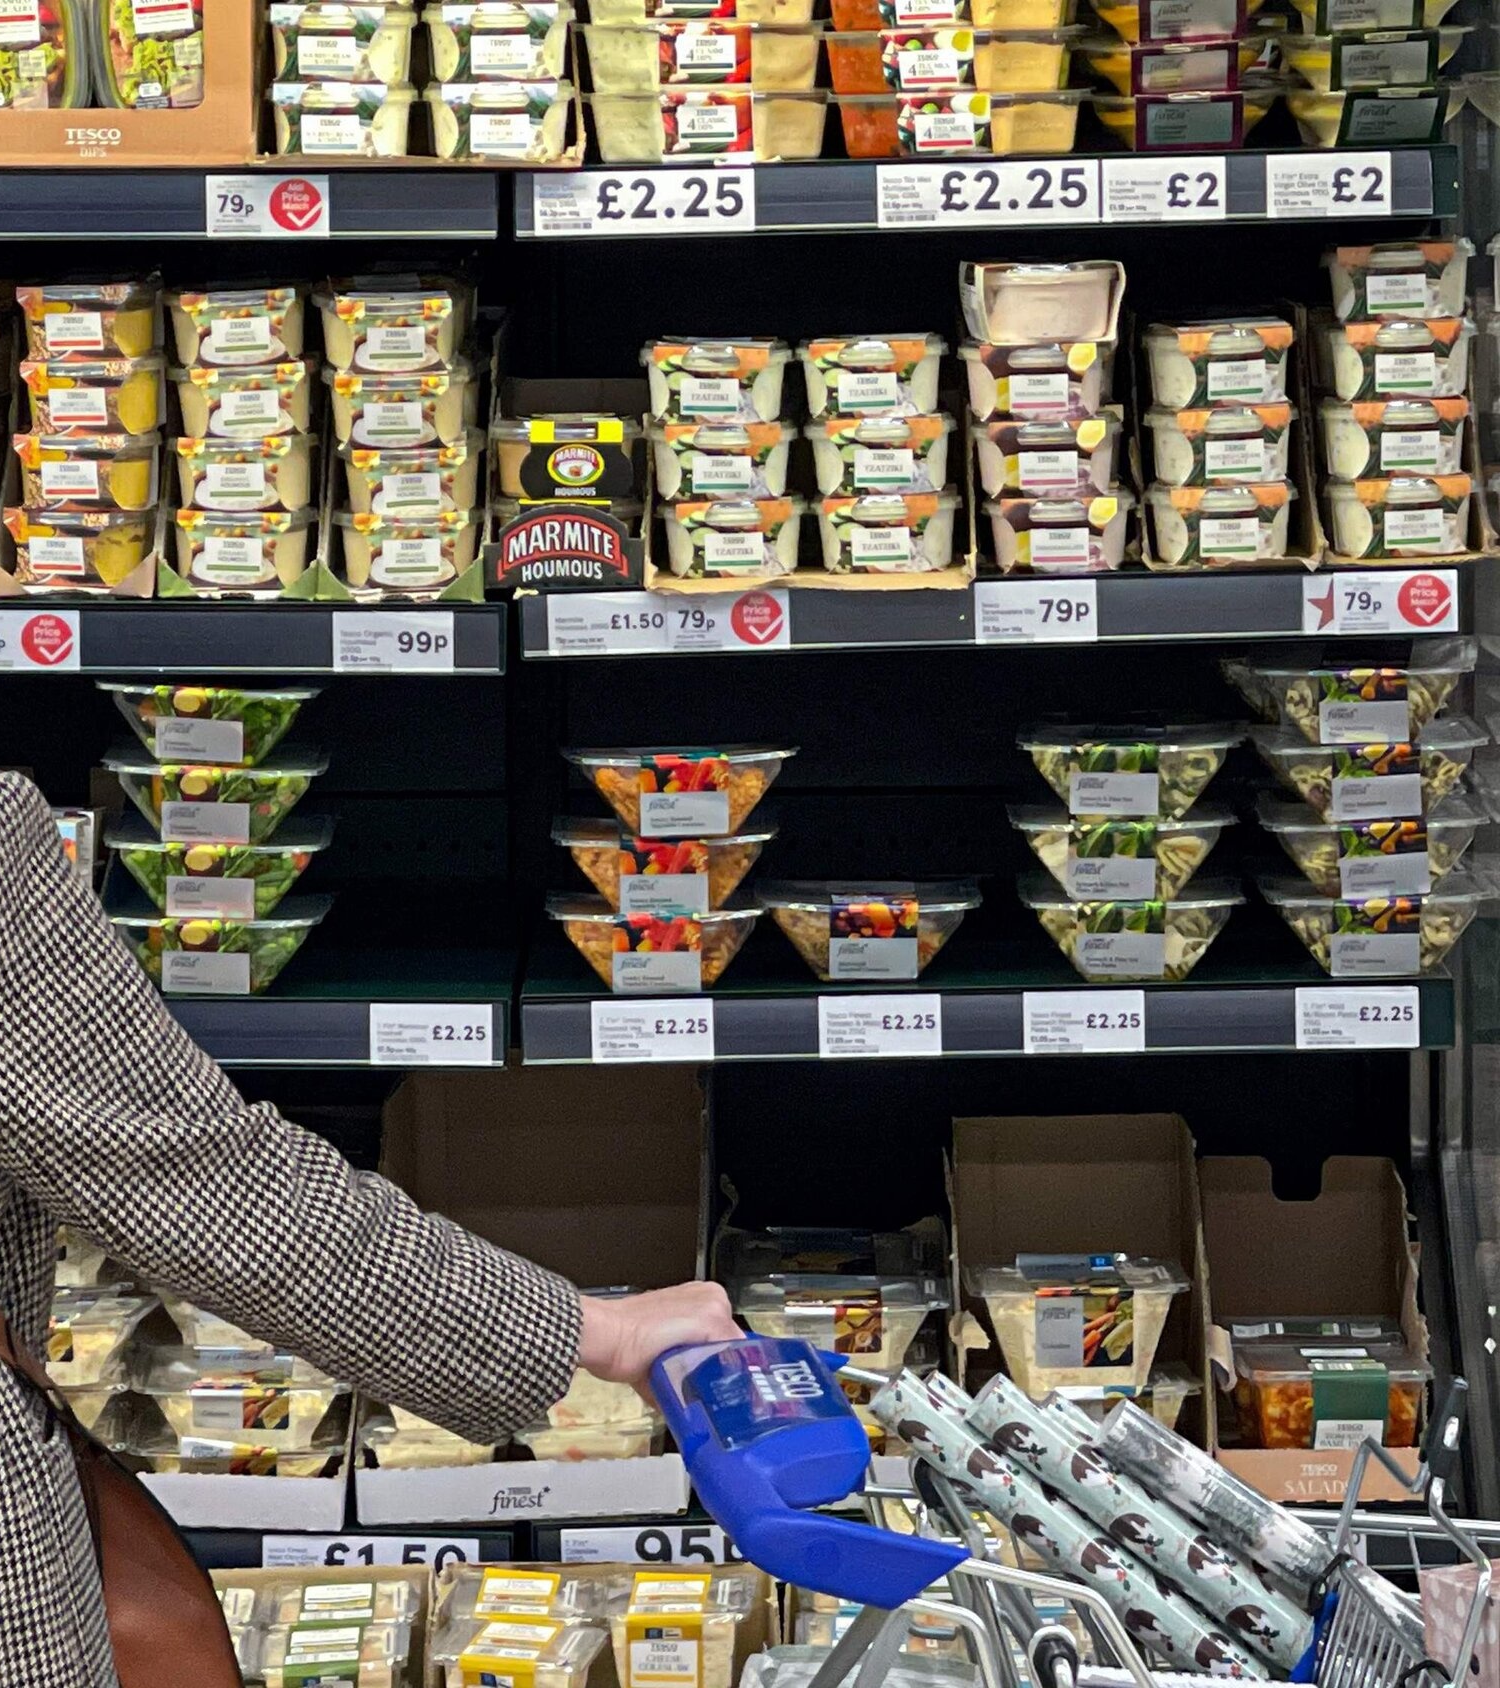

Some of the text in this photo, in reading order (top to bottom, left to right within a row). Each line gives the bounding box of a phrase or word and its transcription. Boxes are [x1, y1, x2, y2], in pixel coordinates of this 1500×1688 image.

[686, 48, 694, 61] 4
[908, 63, 917, 76] 4
[687, 118, 696, 130] 4
[65, 128, 121, 142] TESCO
[923, 127, 932, 139] 4
[940, 168, 1087, 211] £2.25
[1167, 172, 1219, 207] £2
[1332, 166, 1384, 202] £2
[216, 194, 254, 216] 79p
[281, 192, 310, 203] Price
[597, 176, 743, 219] £2.25
[554, 448, 596, 463] MARMITE
[507, 521, 615, 562] MARMITE
[521, 560, 604, 583] HOUMOUS
[1410, 588, 1438, 598] Price
[742, 605, 771, 616] Price
[1039, 599, 1089, 622] 79p
[1344, 592, 1382, 613] 79p
[611, 612, 664, 629] £1.50
[678, 609, 715, 631] 79p
[33, 627, 61, 637] Price
[397, 631, 448, 653] 99p
[1086, 1013, 1141, 1029] £2.25
[1359, 1005, 1414, 1021] £2.25
[655, 1018, 708, 1034] £2.25
[882, 1014, 936, 1030] £2.25
[433, 1025, 486, 1041] £2.25
[769, 1360, 825, 1398] TESCO
[1300, 1464, 1338, 1473] TESCO
[1284, 1480, 1348, 1495] SALAD
[488, 1490, 544, 1514] finest
[324, 1542, 467, 1577] £150
